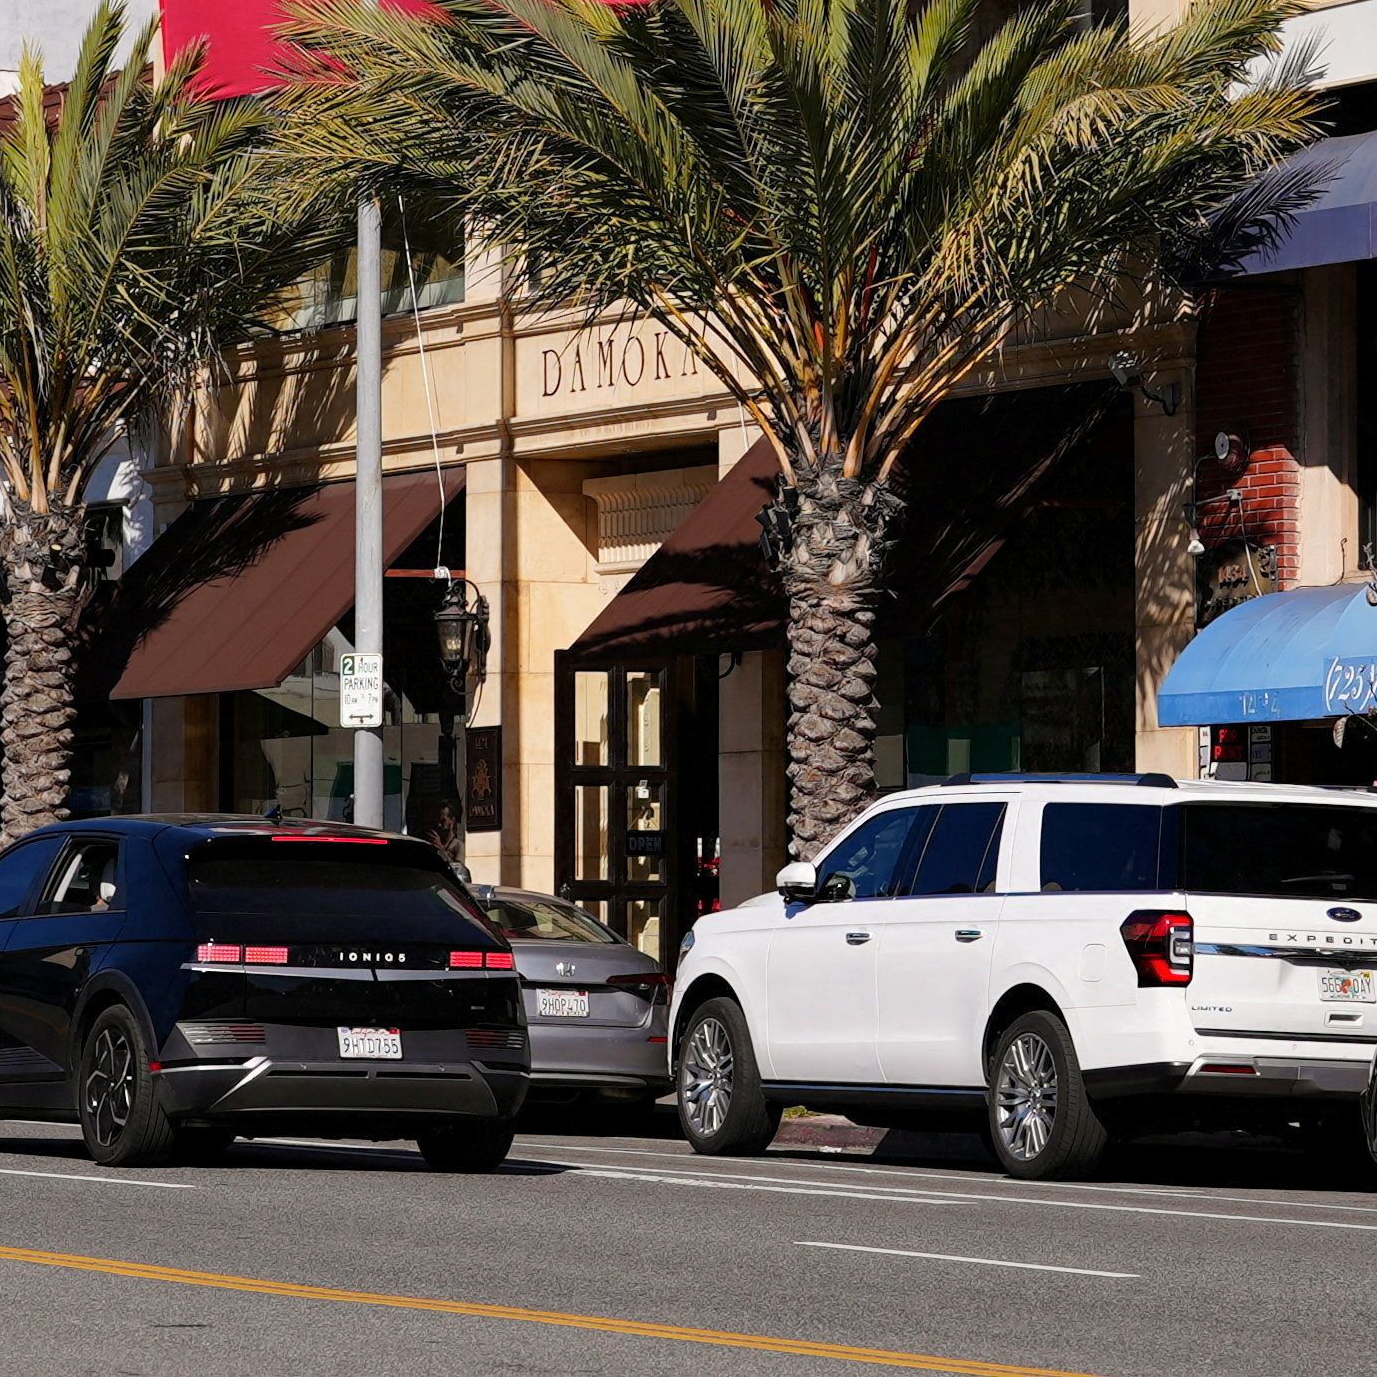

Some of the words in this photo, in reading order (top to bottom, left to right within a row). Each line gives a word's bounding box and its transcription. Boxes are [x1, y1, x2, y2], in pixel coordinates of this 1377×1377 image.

[343, 657, 353, 675] 2
[358, 662, 379, 673] HOUR
[344, 677, 379, 690] PARKING
[628, 835, 662, 852] OPEN
[1191, 1005, 1233, 1013] LIMITED
